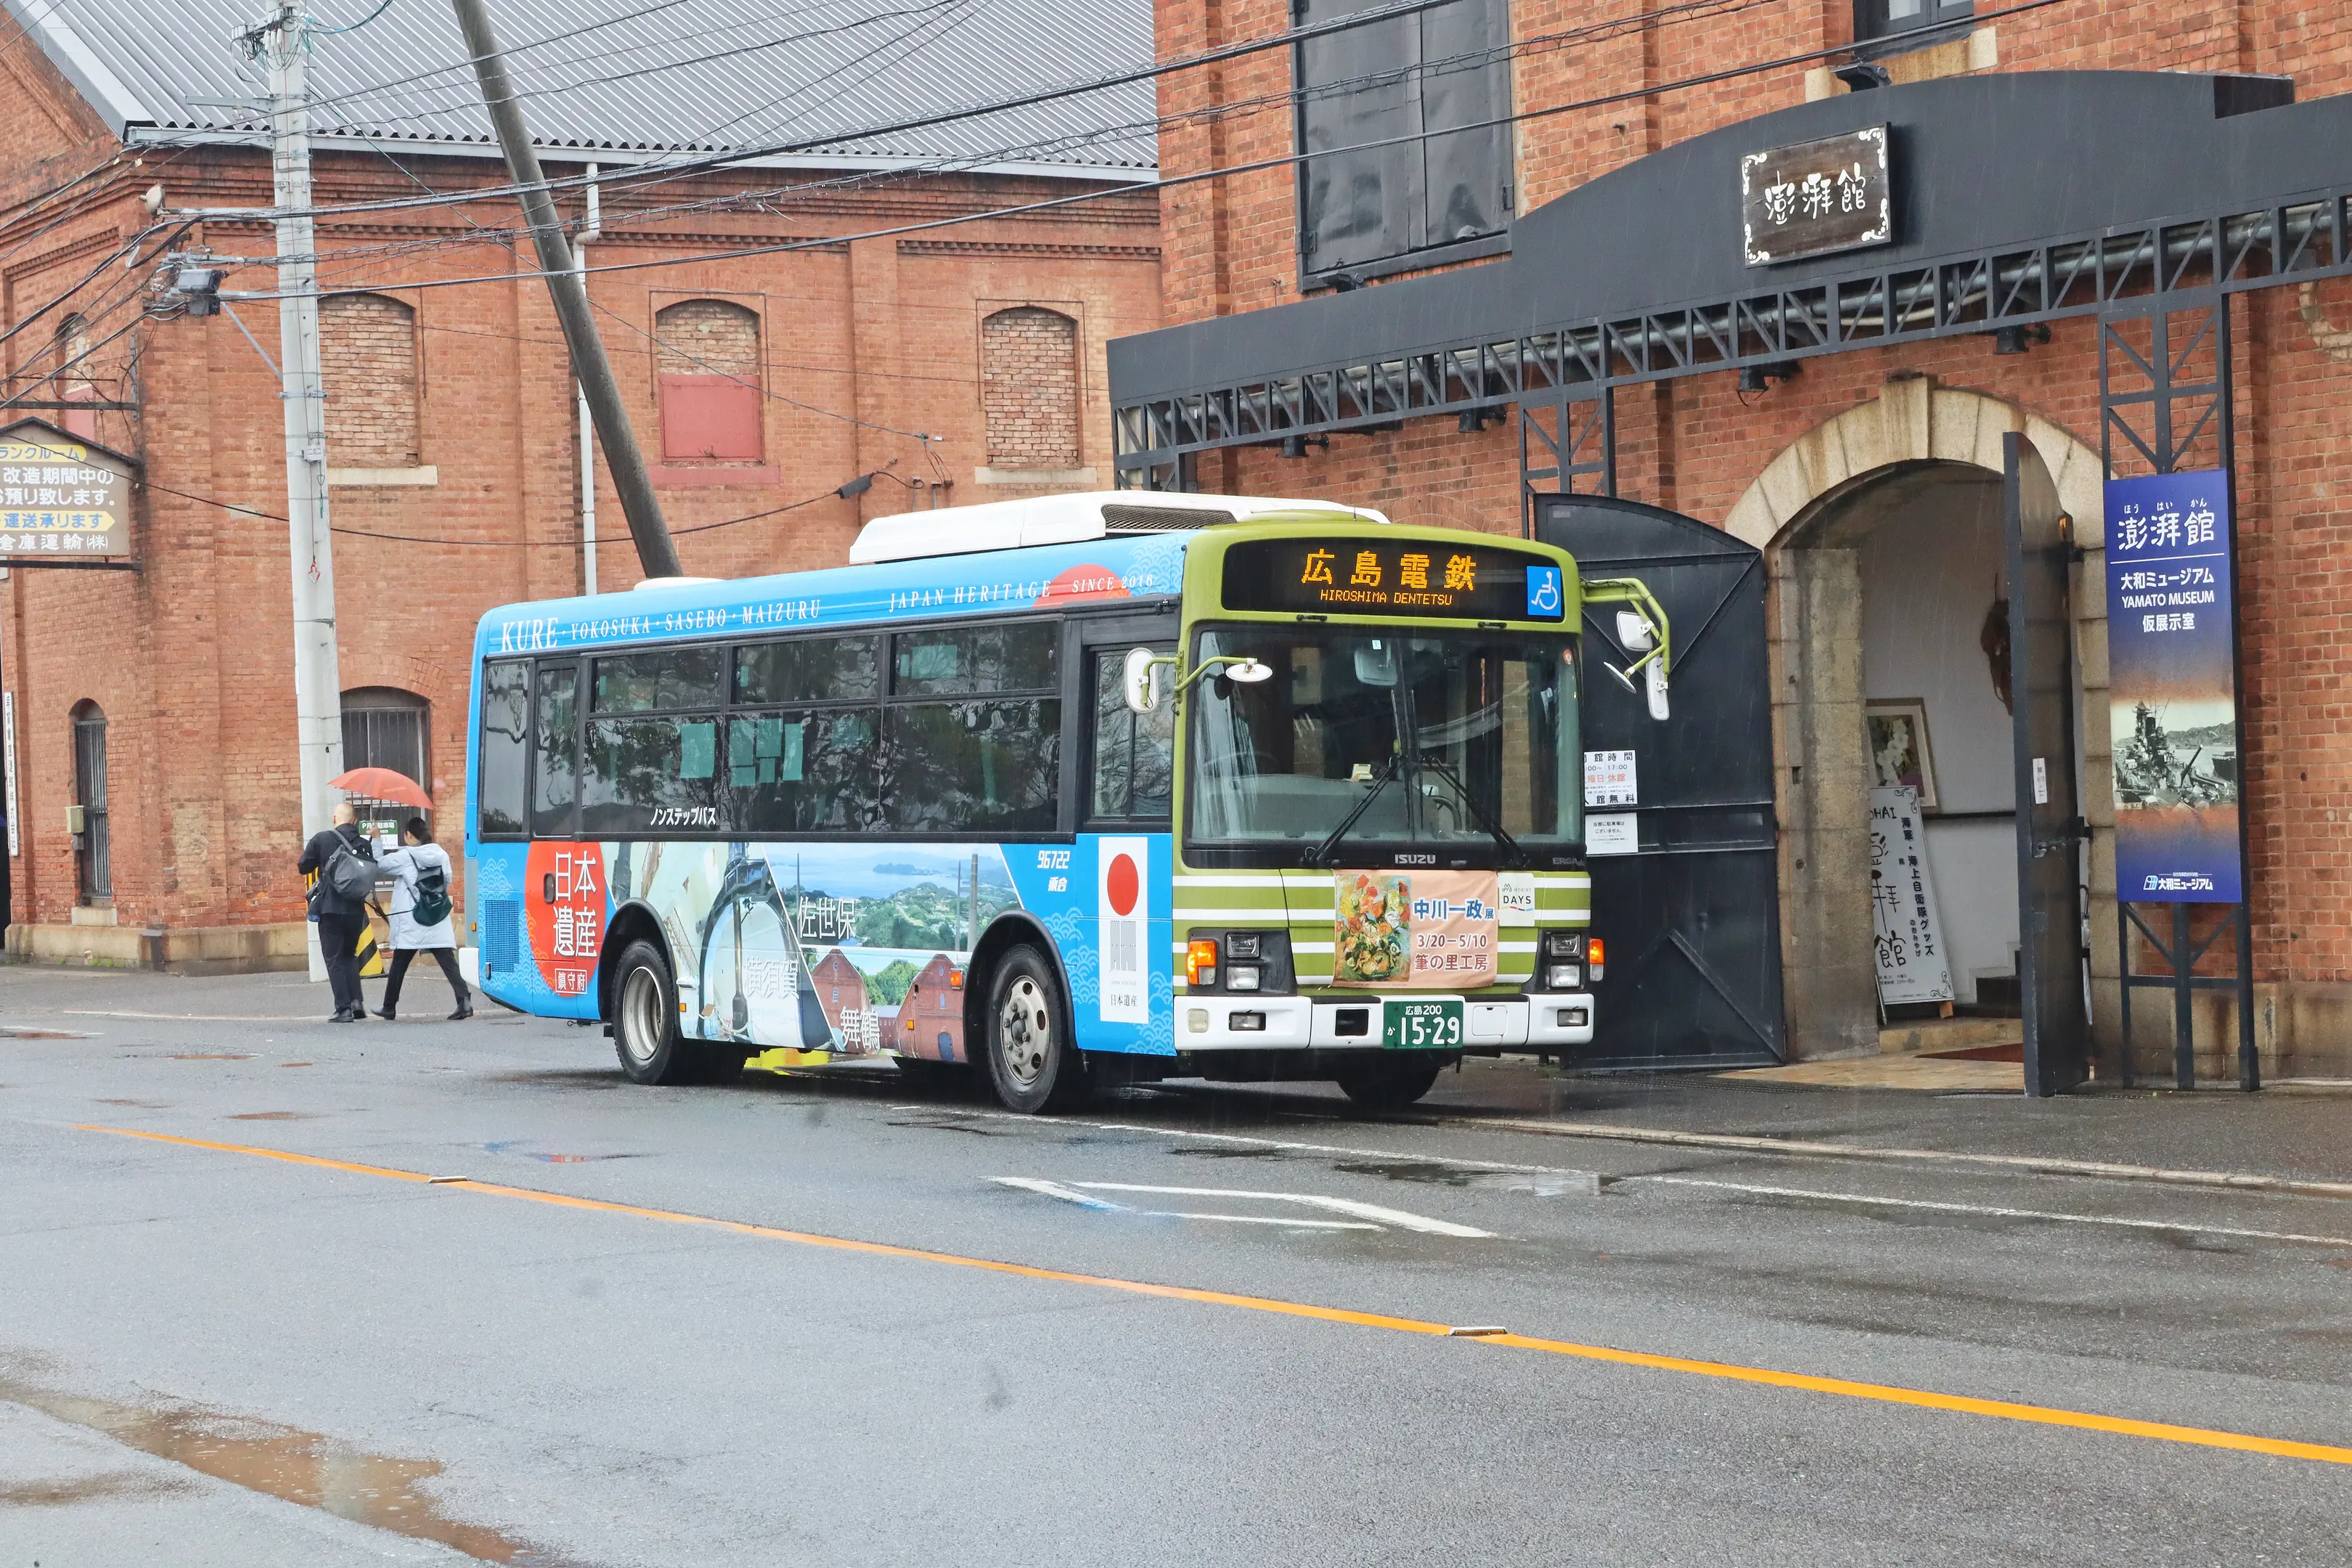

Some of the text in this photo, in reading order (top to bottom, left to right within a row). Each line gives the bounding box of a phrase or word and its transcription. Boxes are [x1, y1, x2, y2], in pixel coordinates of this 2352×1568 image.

[1765, 162, 1866, 225] 澎湃館
[2, 466, 114, 485] 改造期間中の
[2117, 510, 2215, 550] 澎湃館
[1301, 548, 1477, 592] 広島電鉄
[2120, 568, 2214, 590] 大和ミュージアム
[889, 573, 1153, 613] JAPAN HERITAGE SINCE 2016
[1320, 589, 1453, 606] HIROSHIMA DENTETSU
[2121, 590, 2215, 608] YAMATO MUSEUM
[500, 599, 821, 653] KURE YOKOSUKA SASEBO MAIZURU
[2142, 613, 2195, 632] 仮展示室
[1585, 773, 1625, 783] 曜日休館
[650, 807, 716, 826] ノンステップバス
[1037, 850, 1071, 870] 96722
[1395, 854, 1436, 864] ISUZU
[555, 851, 597, 902] 日本
[1048, 877, 1068, 892] 乗合
[2158, 878, 2213, 890] 大和ミュージアム
[1413, 899, 1495, 920] 中川一政展
[1503, 895, 1531, 904] DAYS
[798, 896, 856, 939] 佐世保
[552, 905, 597, 957] 遺産
[1415, 954, 1487, 971] 筆の里工房
[558, 971, 587, 992] 鎮守府
[743, 957, 799, 1000] 横須賀
[1111, 994, 1137, 1007] 日本遺産
[840, 1006, 881, 1053] 舞鶴
[1387, 1017, 1460, 1045] か 15-29
